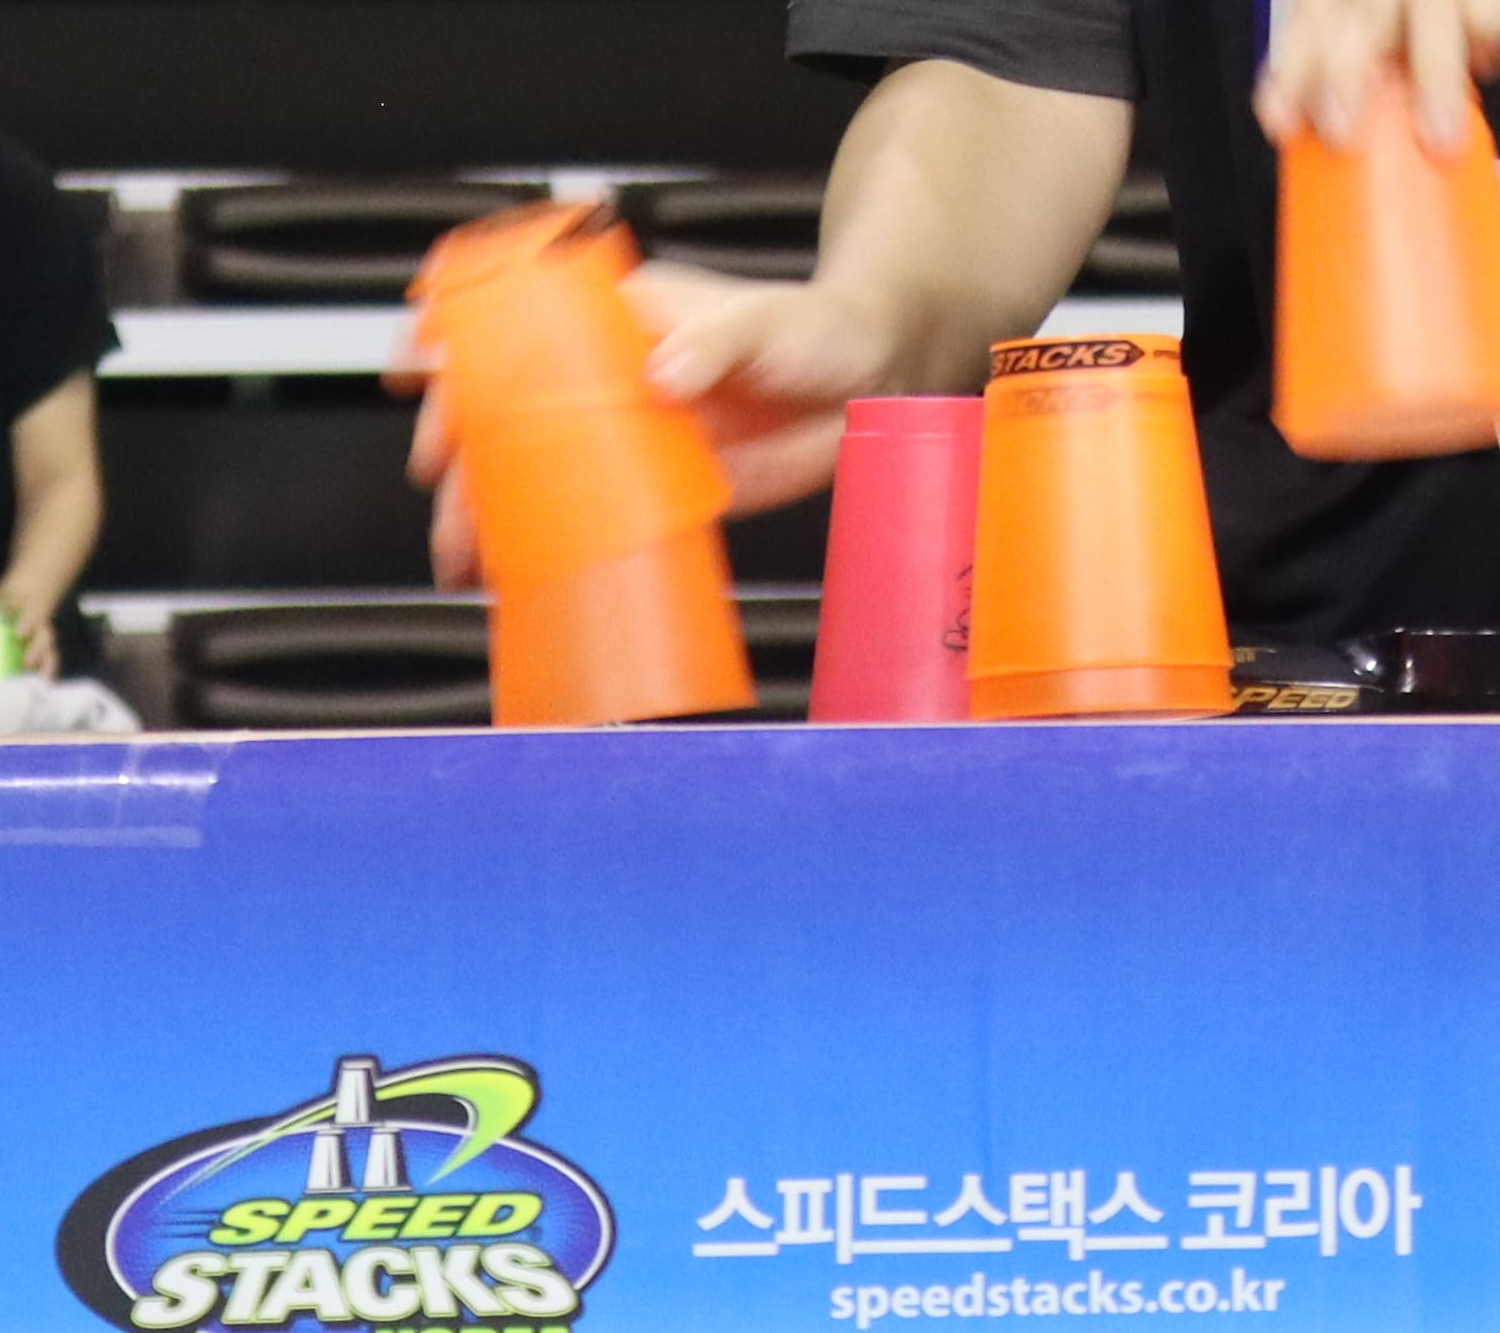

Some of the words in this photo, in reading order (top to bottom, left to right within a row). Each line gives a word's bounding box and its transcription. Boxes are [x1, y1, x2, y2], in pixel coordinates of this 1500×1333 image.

[1231, 687, 1358, 709] PEED
[210, 1193, 543, 1245] SPEED
[692, 1169, 1170, 1265] 스피드스택스
[1180, 1164, 1424, 1257] 코리아
[131, 1242, 578, 1329] STACKS
[830, 1266, 1286, 1330] speedstacks.co.kr
